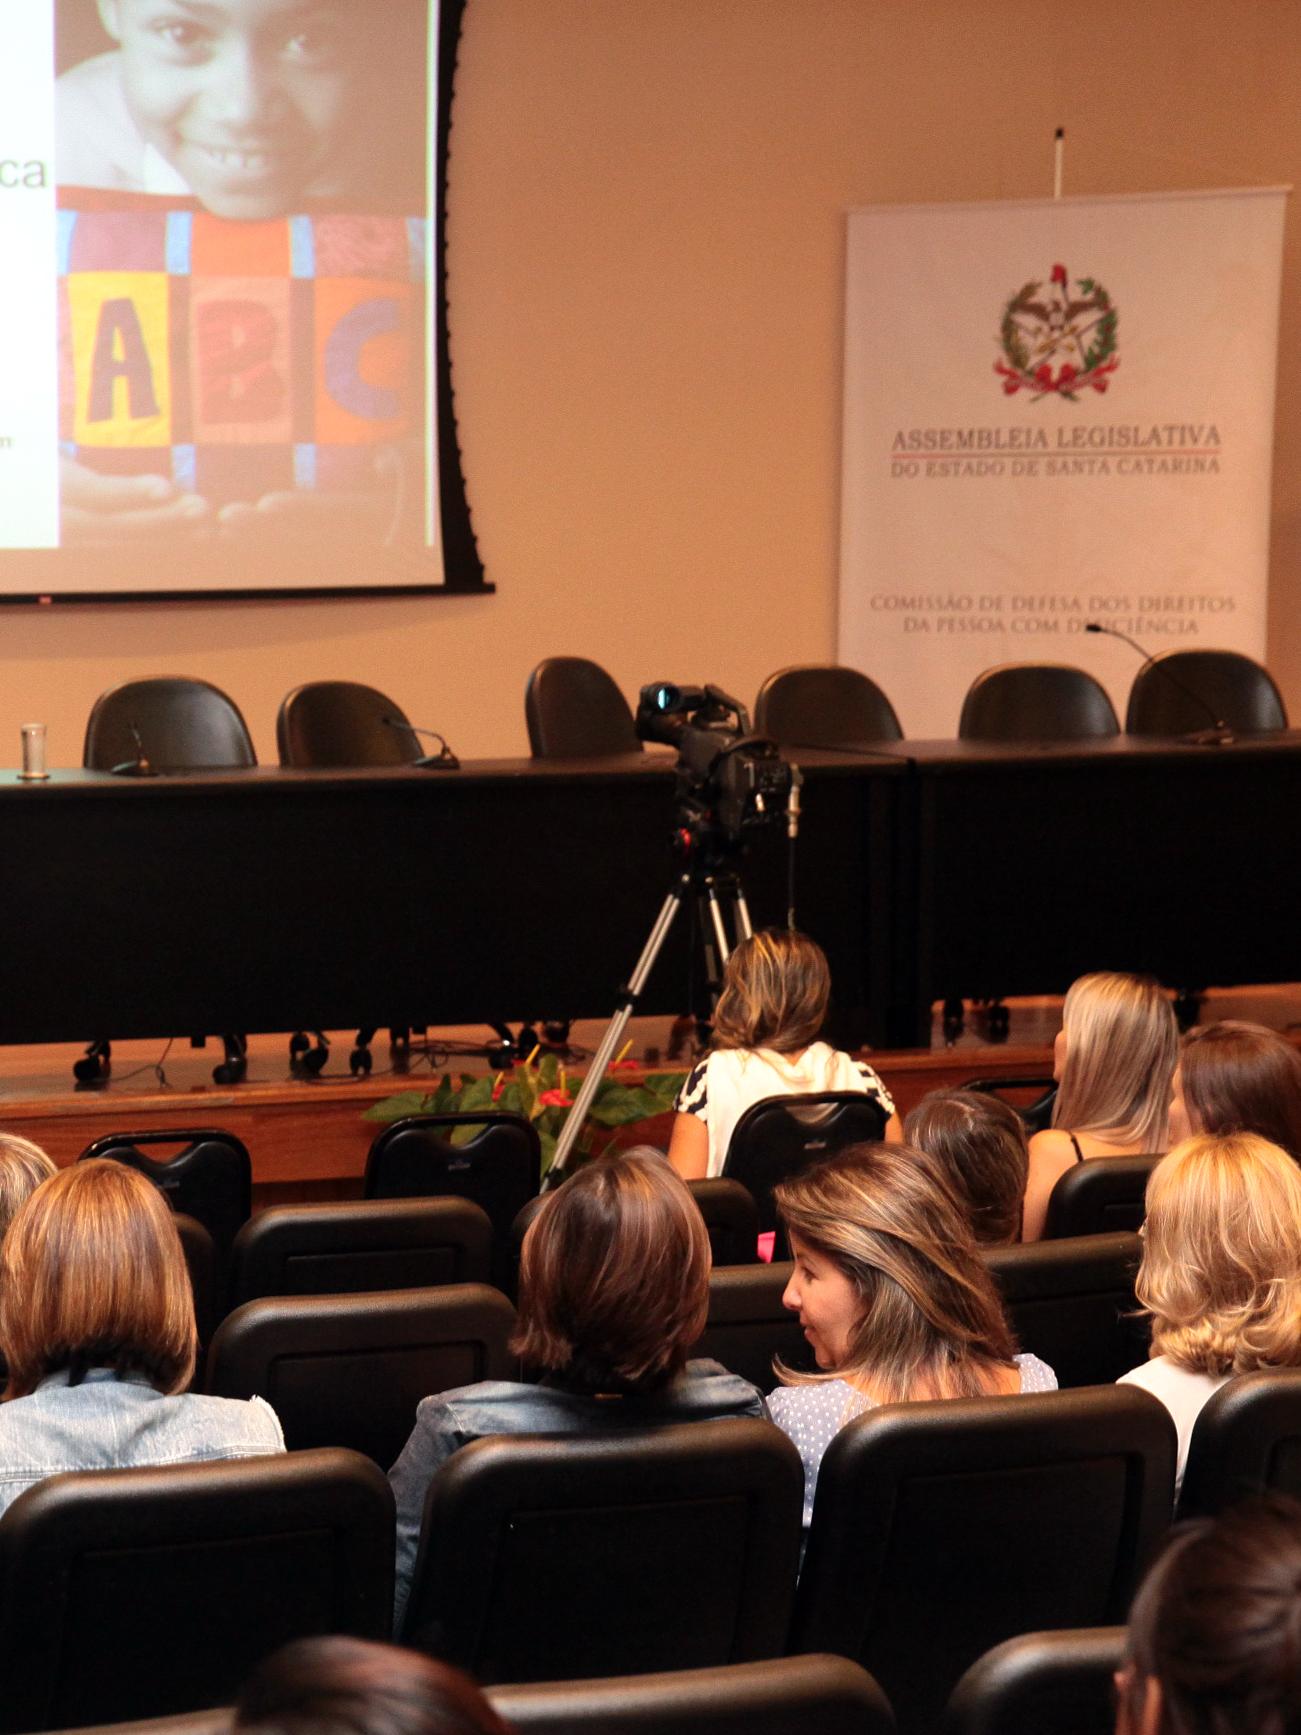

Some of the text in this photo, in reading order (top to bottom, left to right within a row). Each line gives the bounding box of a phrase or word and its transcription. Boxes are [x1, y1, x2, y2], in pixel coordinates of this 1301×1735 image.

[892, 424, 1221, 452] ASSEMBLEIA LEGISLATIVA
[891, 458, 1221, 478] DO ESTADO DE SANTA CATARINA
[870, 592, 973, 611] COMISSÃO
[979, 594, 1007, 611] DE
[1089, 593, 1131, 611] DOS
[1138, 593, 1236, 611] DIREITOS
[903, 617, 930, 634] DA
[937, 617, 1005, 634] PESSOA
[1011, 617, 1059, 634] COM
